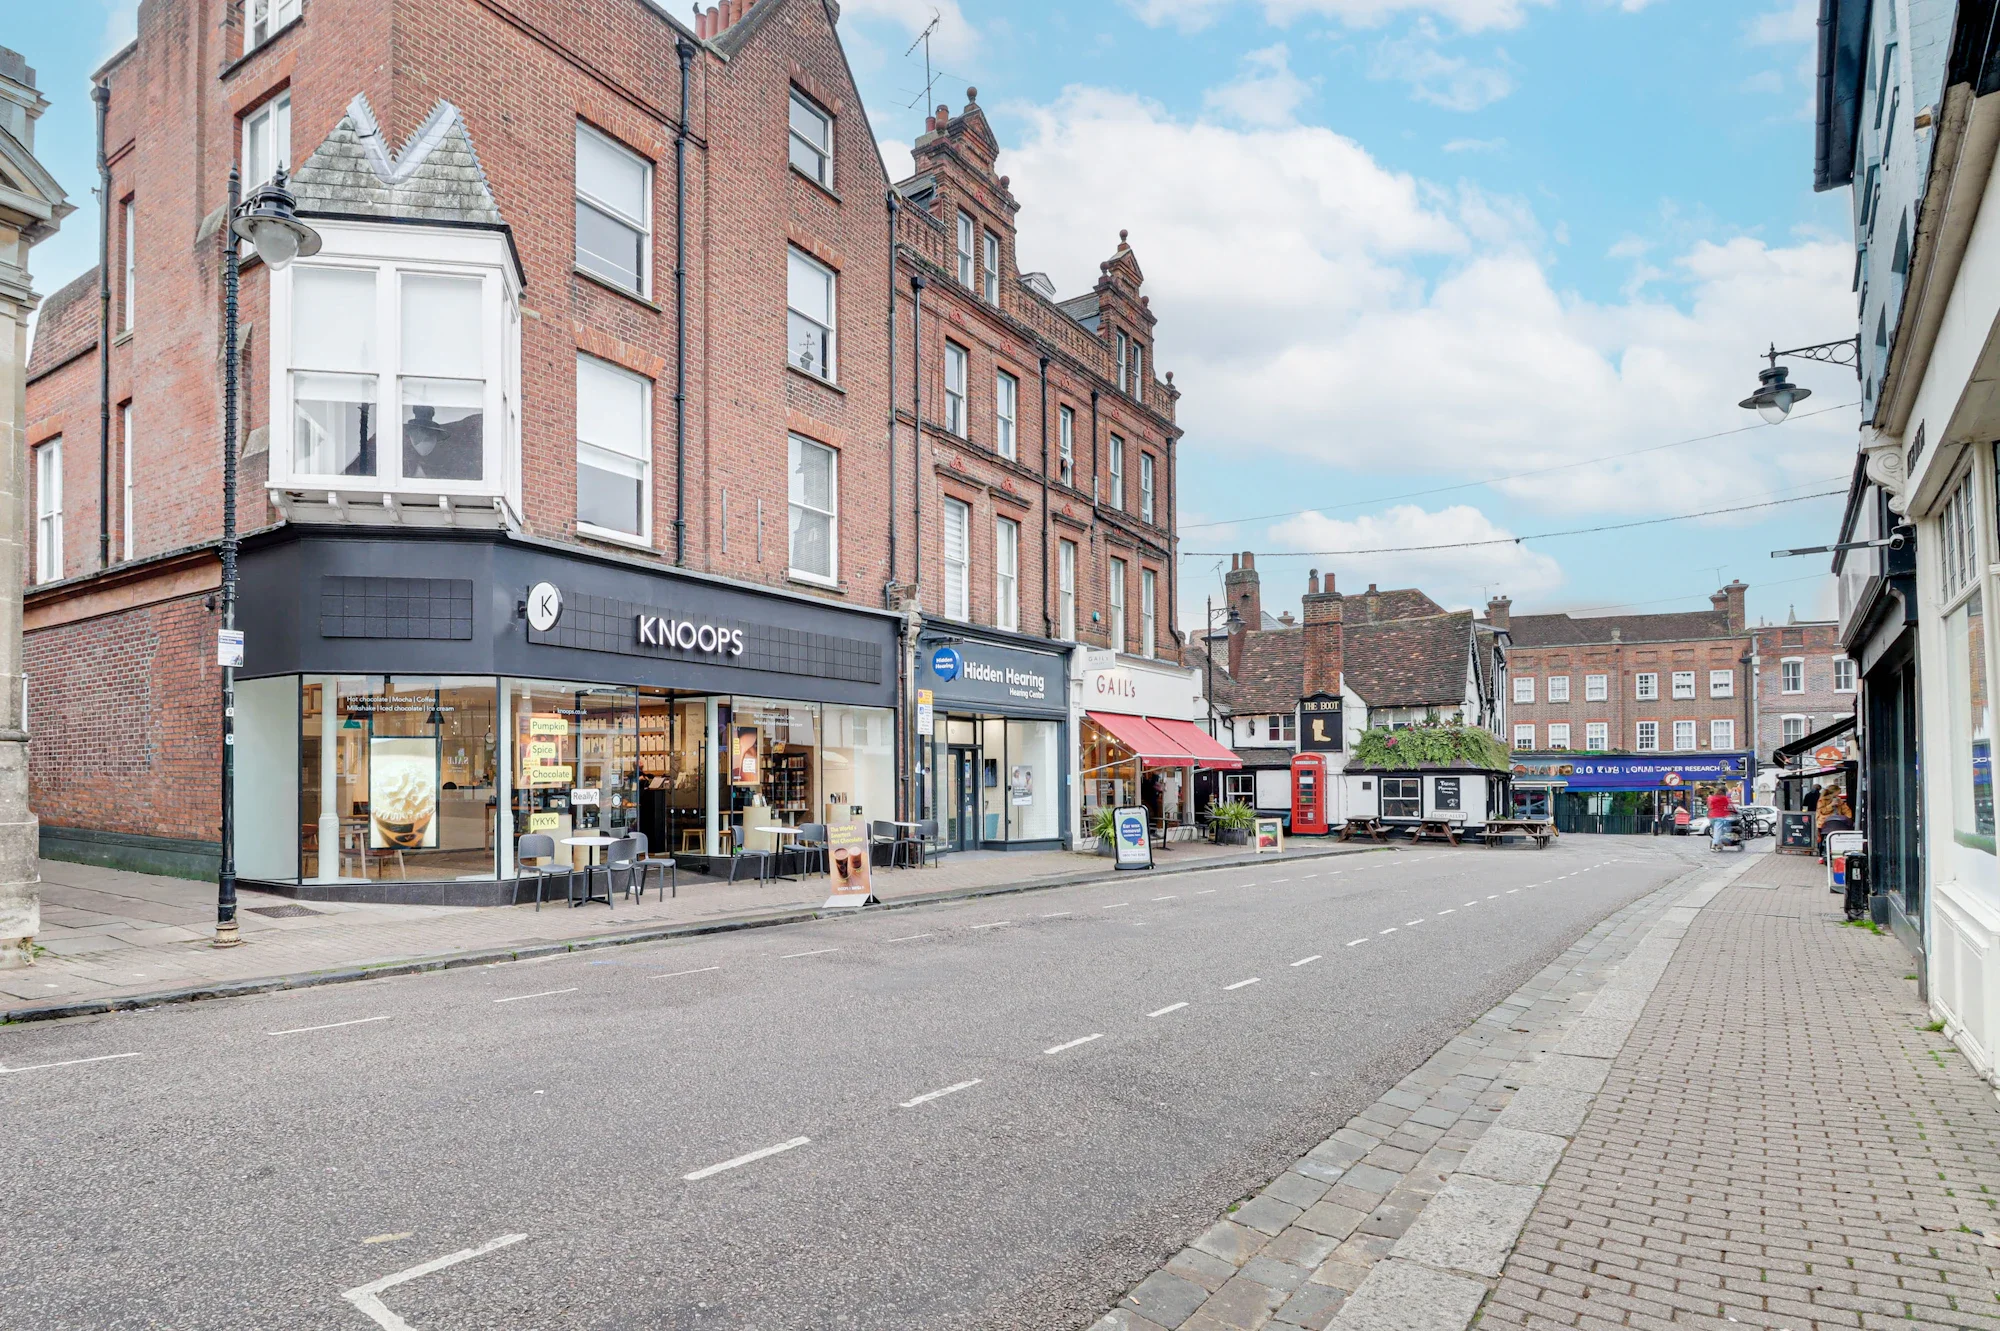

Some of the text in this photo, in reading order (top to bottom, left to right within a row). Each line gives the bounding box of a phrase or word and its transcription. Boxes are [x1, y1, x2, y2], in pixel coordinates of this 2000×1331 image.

[541, 595, 552, 617] K
[638, 614, 744, 656] KNOOPS
[963, 661, 1045, 691] Hidden Hearing
[1097, 674, 1136, 698] GAIL's
[1009, 687, 1045, 700] Hearing Centre
[1303, 701, 1340, 711] THE BOOT
[557, 708, 588, 716] knoops.co.uk
[532, 721, 565, 731] Pumpkin
[532, 745, 553, 754] Spice
[532, 769, 570, 779] Chocolate
[573, 791, 598, 803] Really?
[532, 817, 556, 826] IYKYK
